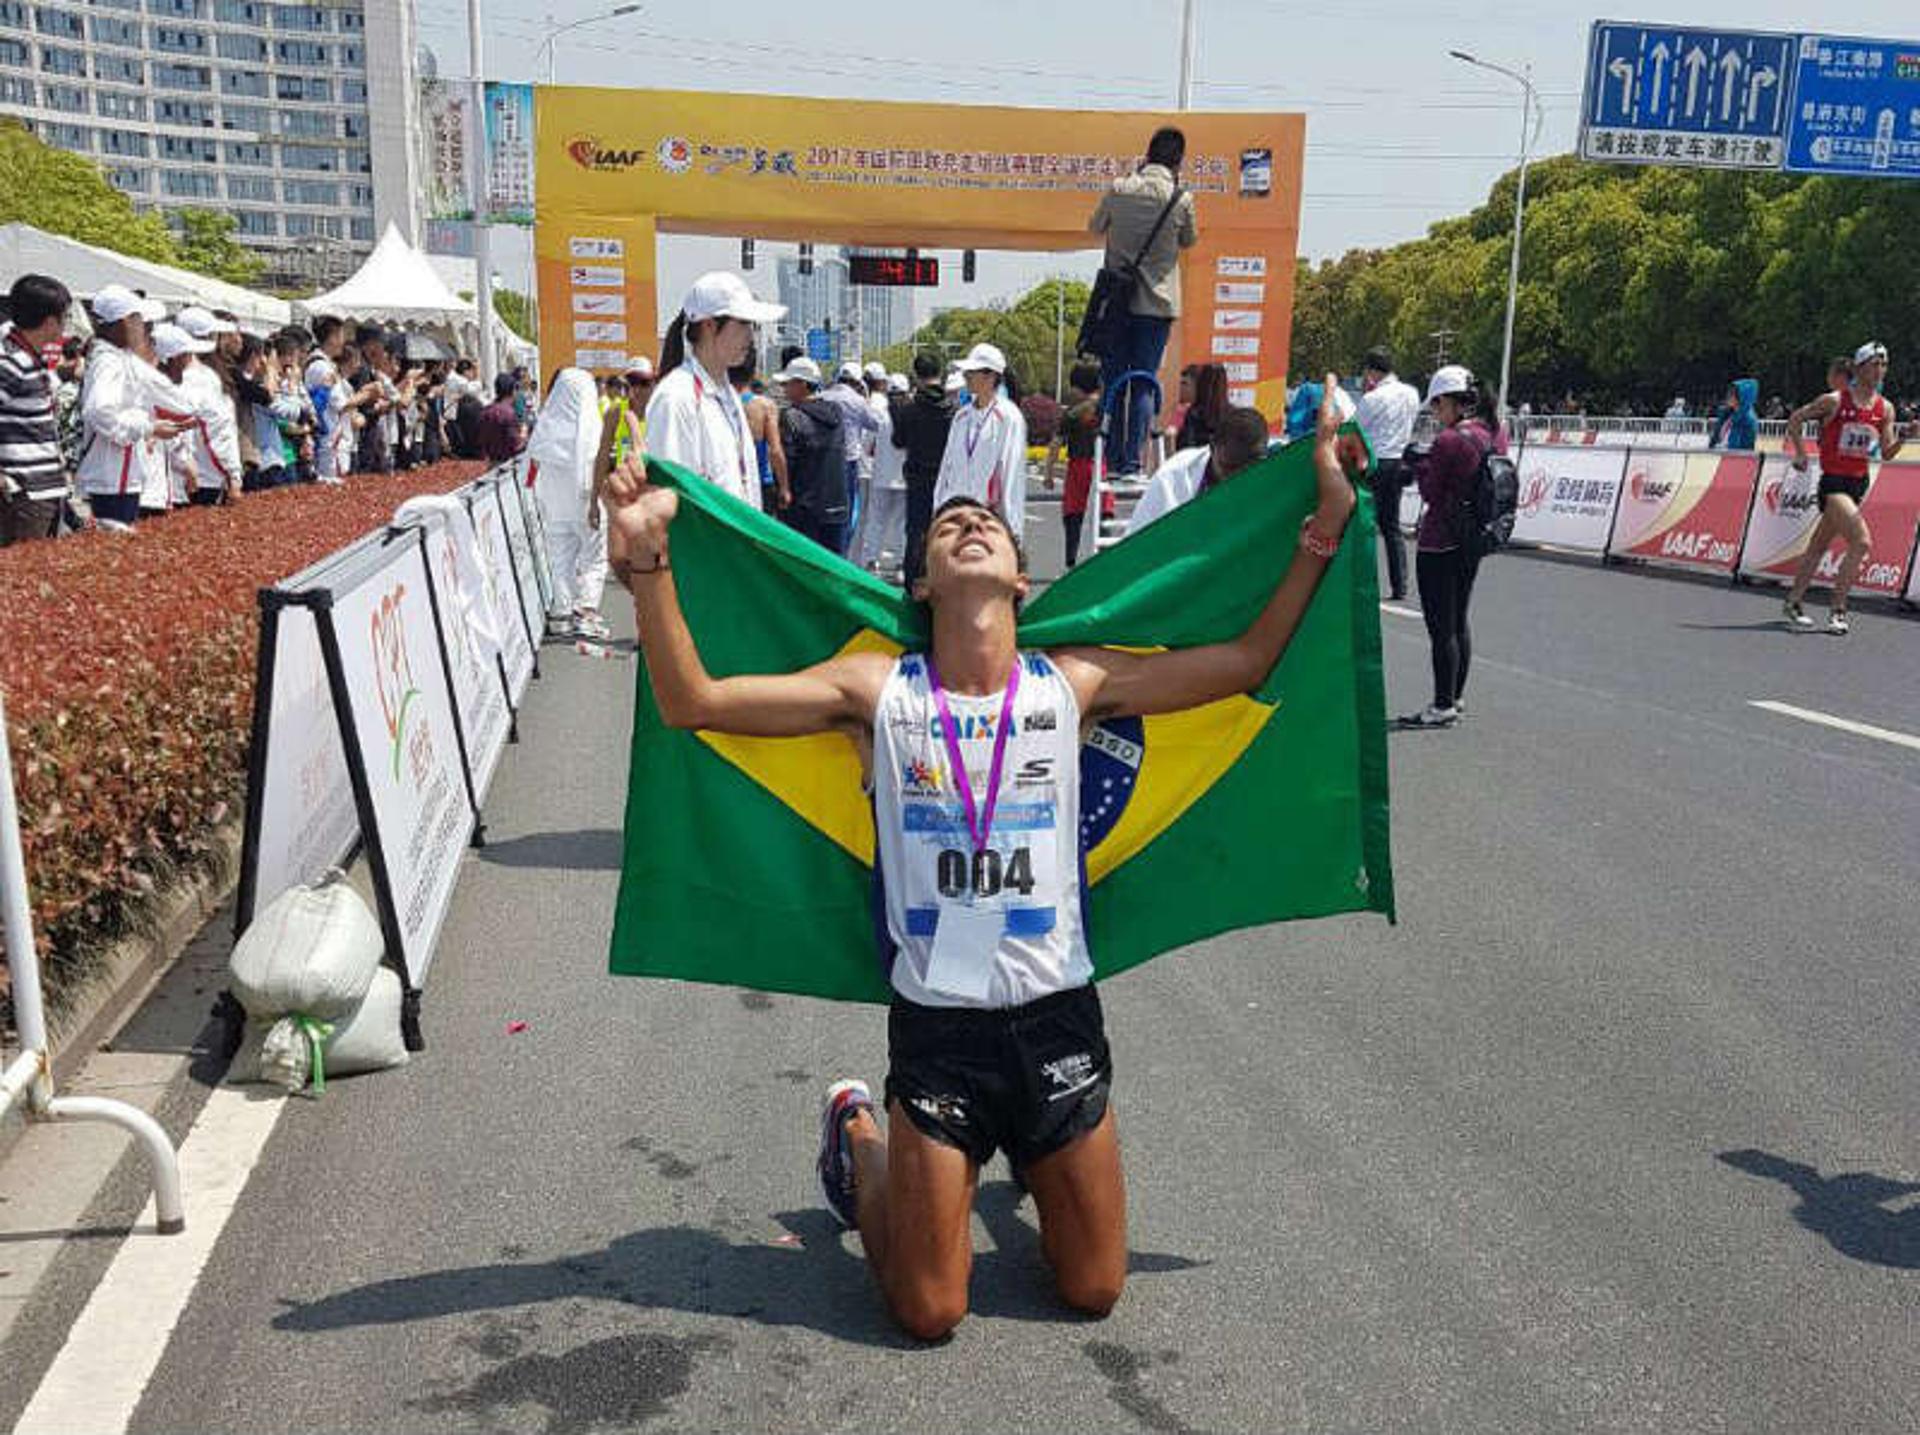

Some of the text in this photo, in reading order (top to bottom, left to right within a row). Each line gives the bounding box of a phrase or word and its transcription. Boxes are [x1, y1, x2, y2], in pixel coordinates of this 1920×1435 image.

[594, 149, 645, 167] IAAF
[1594, 131, 1772, 163] 请按规定车道行驶
[1661, 530, 1736, 562] IAAF.ORG
[936, 847, 1036, 898] 004
